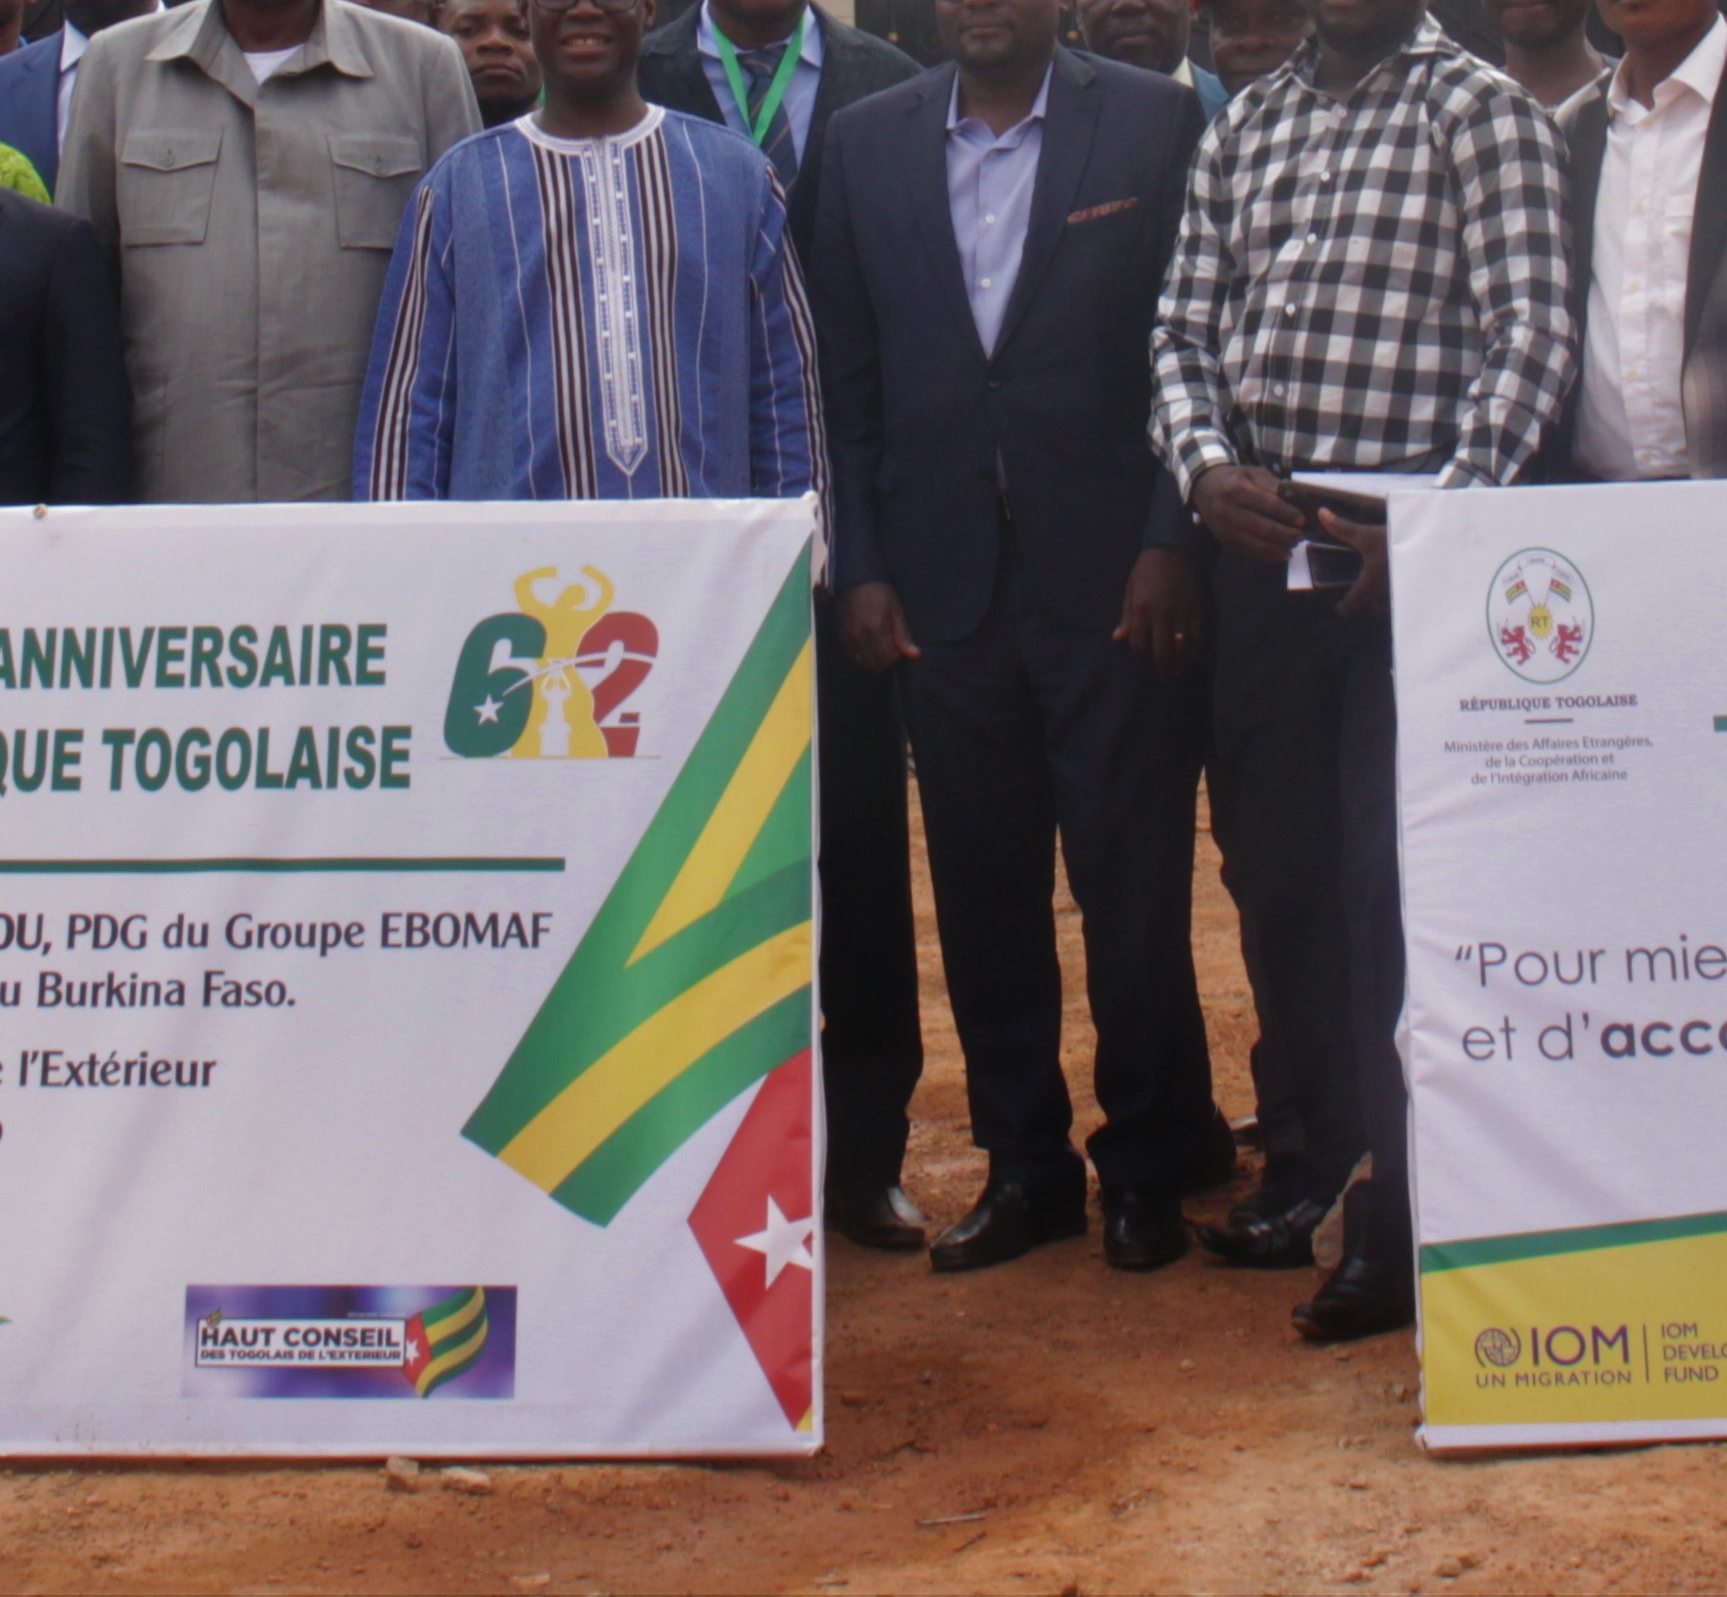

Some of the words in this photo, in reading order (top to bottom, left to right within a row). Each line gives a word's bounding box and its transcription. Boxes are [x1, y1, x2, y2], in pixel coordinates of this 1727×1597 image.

[1531, 615, 1549, 628] RT
[1459, 696, 1551, 712] RÉPUBLIQUE
[1556, 694, 1638, 708] TOGOLAISE
[1444, 740, 1503, 752] Ministère
[1506, 739, 1529, 751] des
[1532, 737, 1580, 750] Affaires
[1583, 735, 1654, 750] Etrangères,
[102, 725, 412, 792] TOGOLAISE
[1485, 756, 1501, 768] de
[1504, 756, 1516, 767] la
[1519, 753, 1599, 768] Coopération
[1601, 753, 1615, 764] et
[1471, 773, 1487, 784] de
[1490, 770, 1568, 786] l'Intégration
[1572, 768, 1628, 781] Africaine
[67, 914, 147, 950] PDG
[163, 914, 209, 949] du
[225, 913, 364, 957] Groupe
[381, 913, 552, 948] EBOMAF
[38, 971, 185, 1007] Burkina
[203, 970, 295, 1007] Faso.
[1461, 1015, 1516, 1061] et
[20, 1051, 216, 1087] l'Extérieur
[201, 1328, 276, 1347] HAUT
[284, 1328, 399, 1347] CONSEIL
[1661, 1322, 1698, 1339] IOM
[201, 1349, 225, 1360] DES
[230, 1350, 294, 1360] TOGOLAIS
[298, 1350, 315, 1360] DE
[319, 1350, 401, 1360] L'EXTERIEUR
[1531, 1325, 1629, 1366] IOM
[1476, 1373, 1506, 1389] UN
[1515, 1369, 1632, 1387] MIGRATION
[1664, 1365, 1719, 1383] FUND
